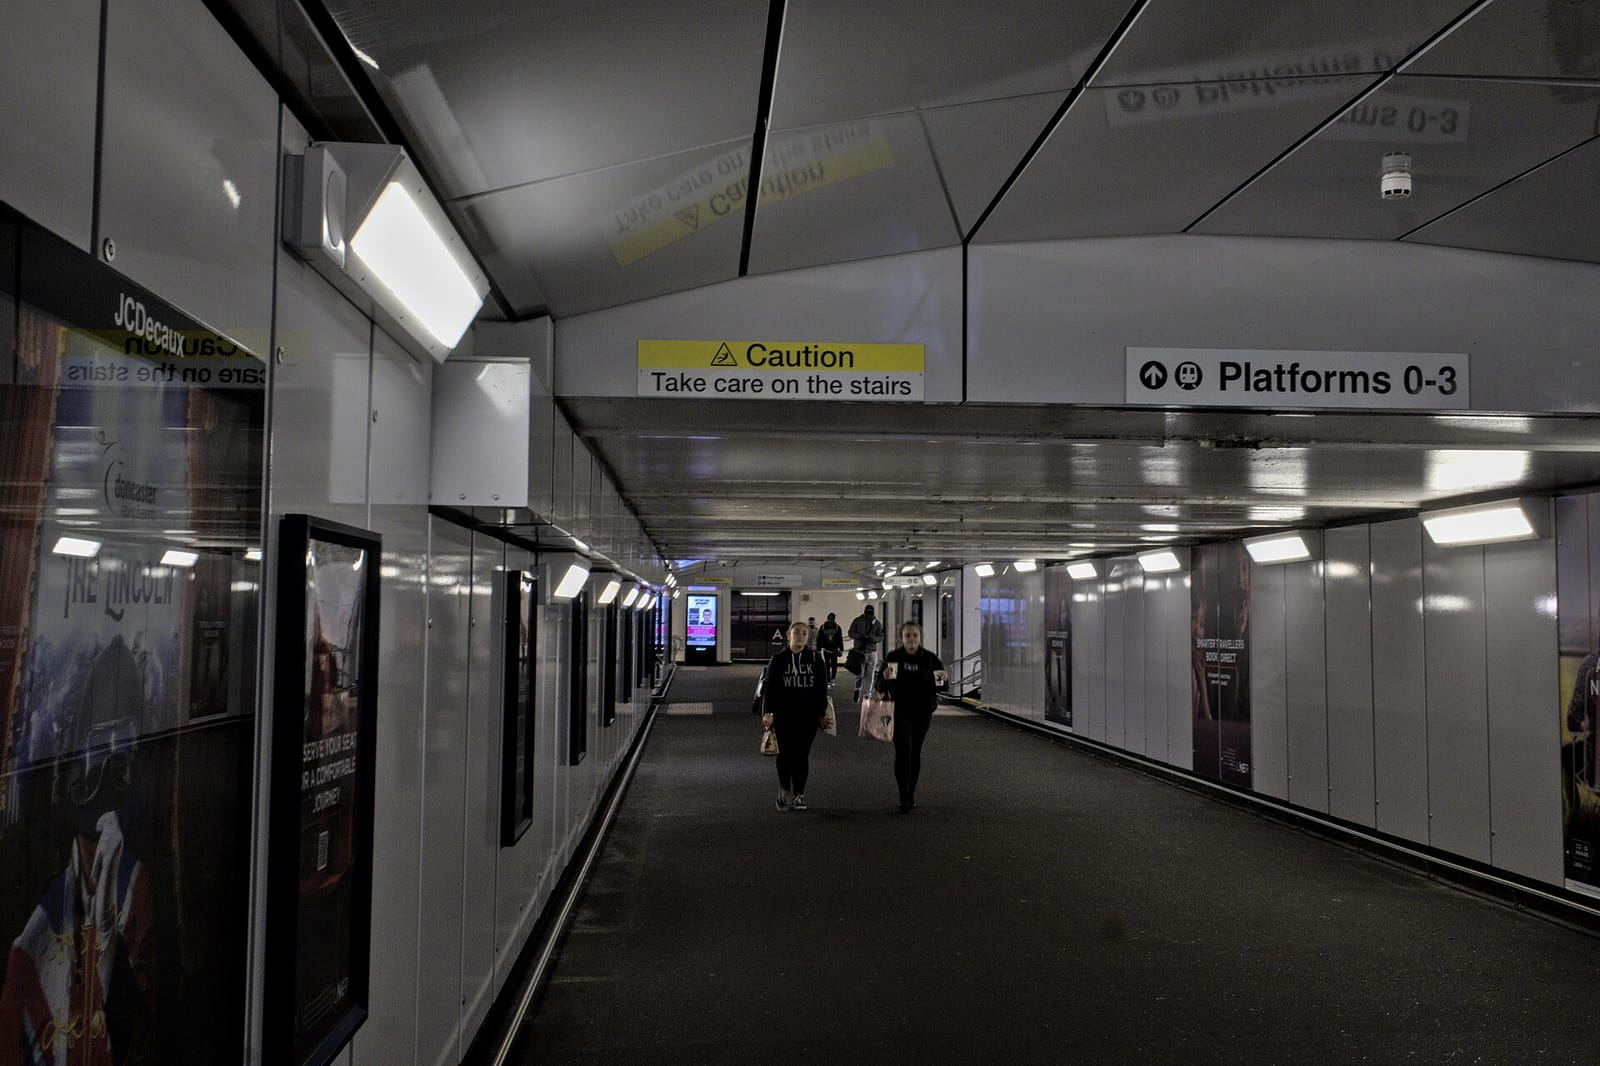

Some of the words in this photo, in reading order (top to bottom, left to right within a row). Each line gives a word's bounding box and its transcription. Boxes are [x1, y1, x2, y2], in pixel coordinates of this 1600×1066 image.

[114, 293, 185, 358] JCDecaux
[746, 343, 854, 368] Caution
[651, 372, 706, 392] Take
[714, 376, 763, 393] care
[771, 377, 799, 394] on
[807, 374, 843, 395] the
[850, 376, 912, 395] stairs
[1219, 361, 1391, 395] Platforms
[1403, 365, 1458, 395] 0-3
[781, 674, 815, 688] WILLS
